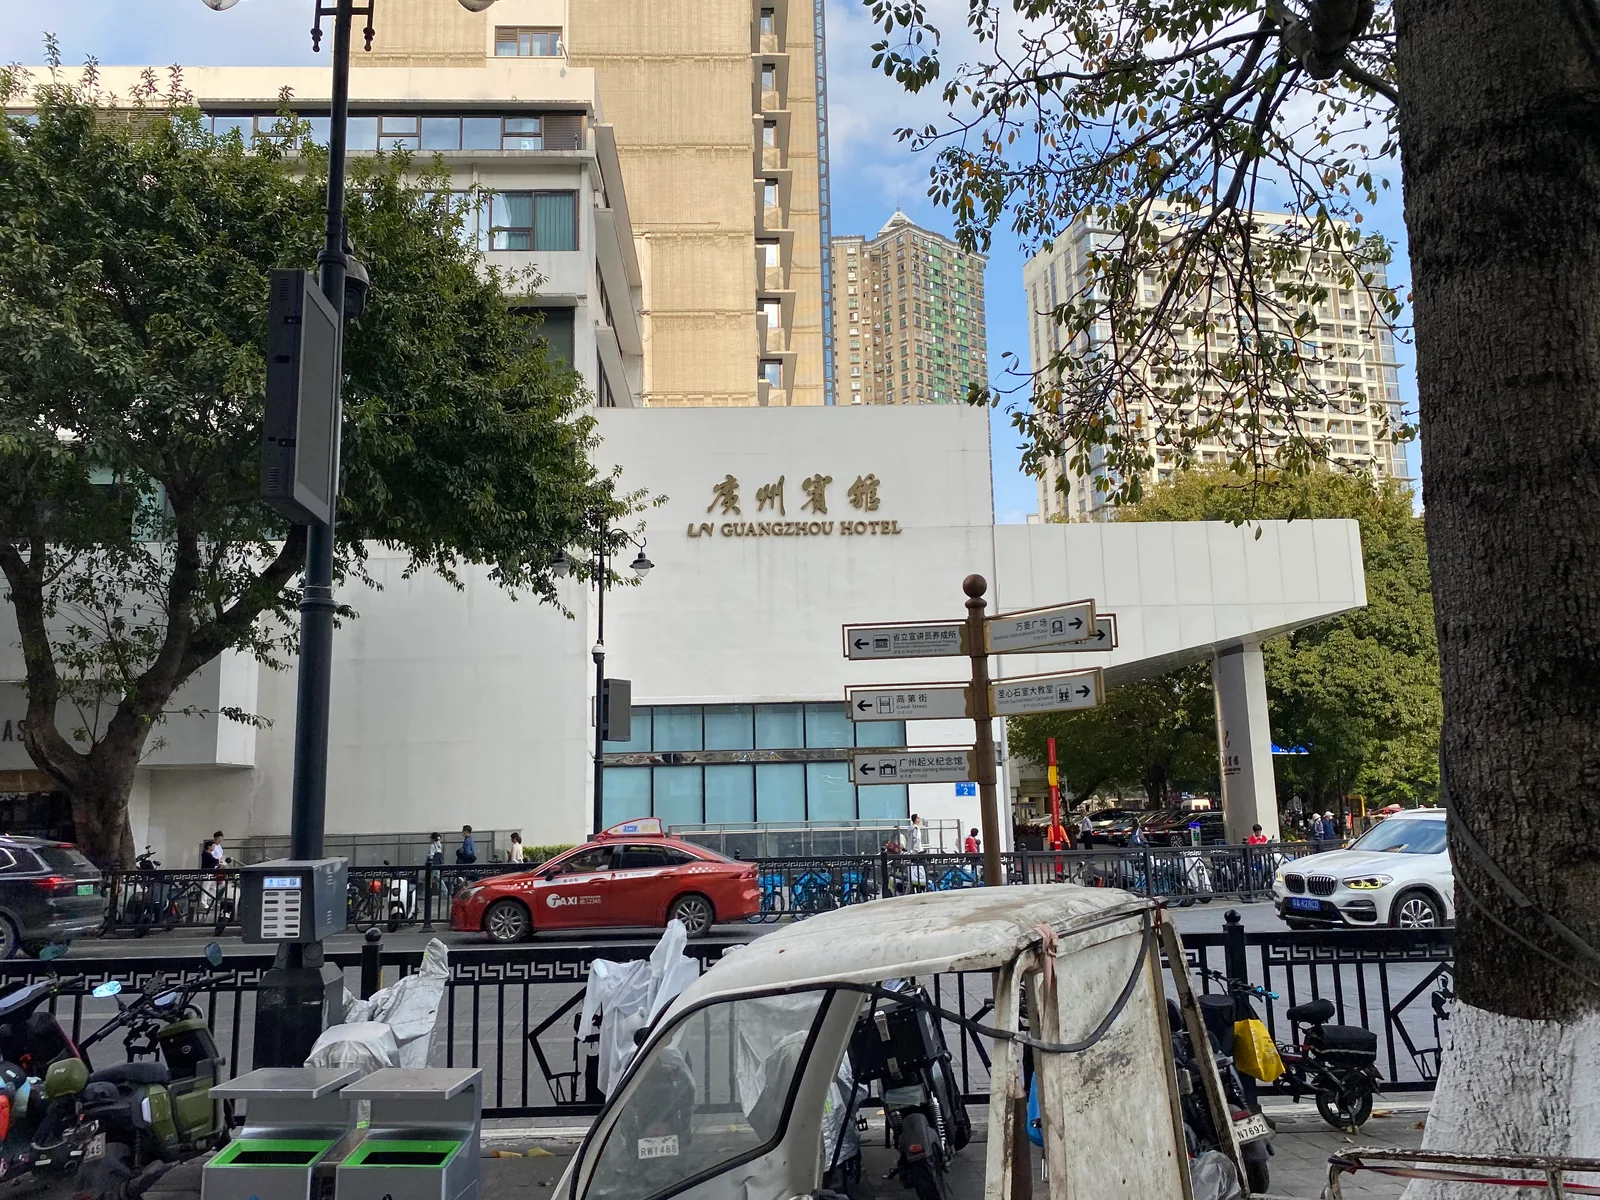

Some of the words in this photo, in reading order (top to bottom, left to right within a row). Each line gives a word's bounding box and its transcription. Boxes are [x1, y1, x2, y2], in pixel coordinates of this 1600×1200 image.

[687, 522, 714, 538] LN
[721, 520, 835, 537] GUANGZHOU
[840, 519, 903, 535] HOTEL
[893, 630, 956, 642] 省立宣讲员养成所
[998, 684, 1054, 699] 圣心石室大教堂
[896, 693, 928, 704] 高第街
[900, 756, 963, 767] 广州起义纪念馆
[963, 787, 969, 795] 2
[549, 894, 578, 907] TAXI
[1237, 1123, 1266, 1140] N7692
